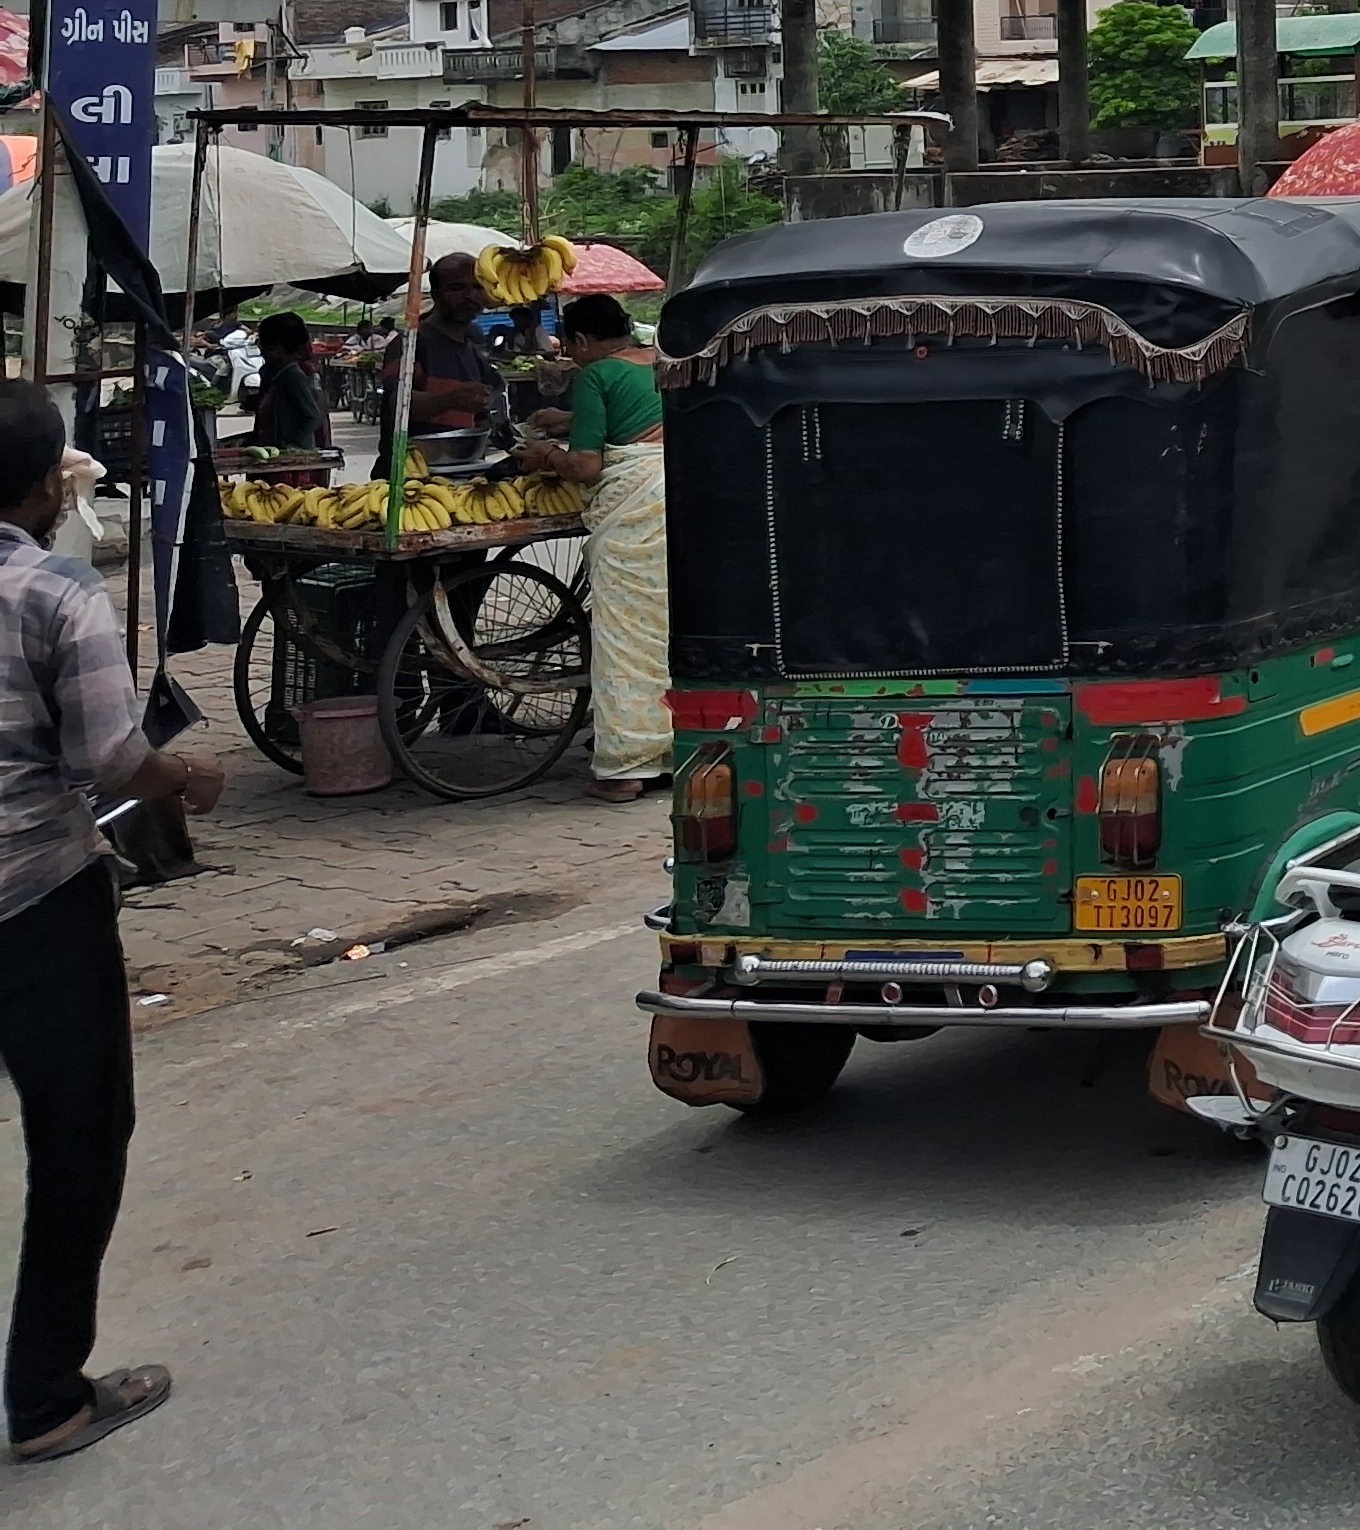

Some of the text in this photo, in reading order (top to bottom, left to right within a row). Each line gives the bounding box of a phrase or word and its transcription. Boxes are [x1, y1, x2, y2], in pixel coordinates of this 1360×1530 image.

[61, 7, 149, 45] ગ્રીન પીસ
[71, 85, 133, 124] લી
[1107, 879, 1160, 902] GJ02
[1093, 905, 1175, 928] TT3097
